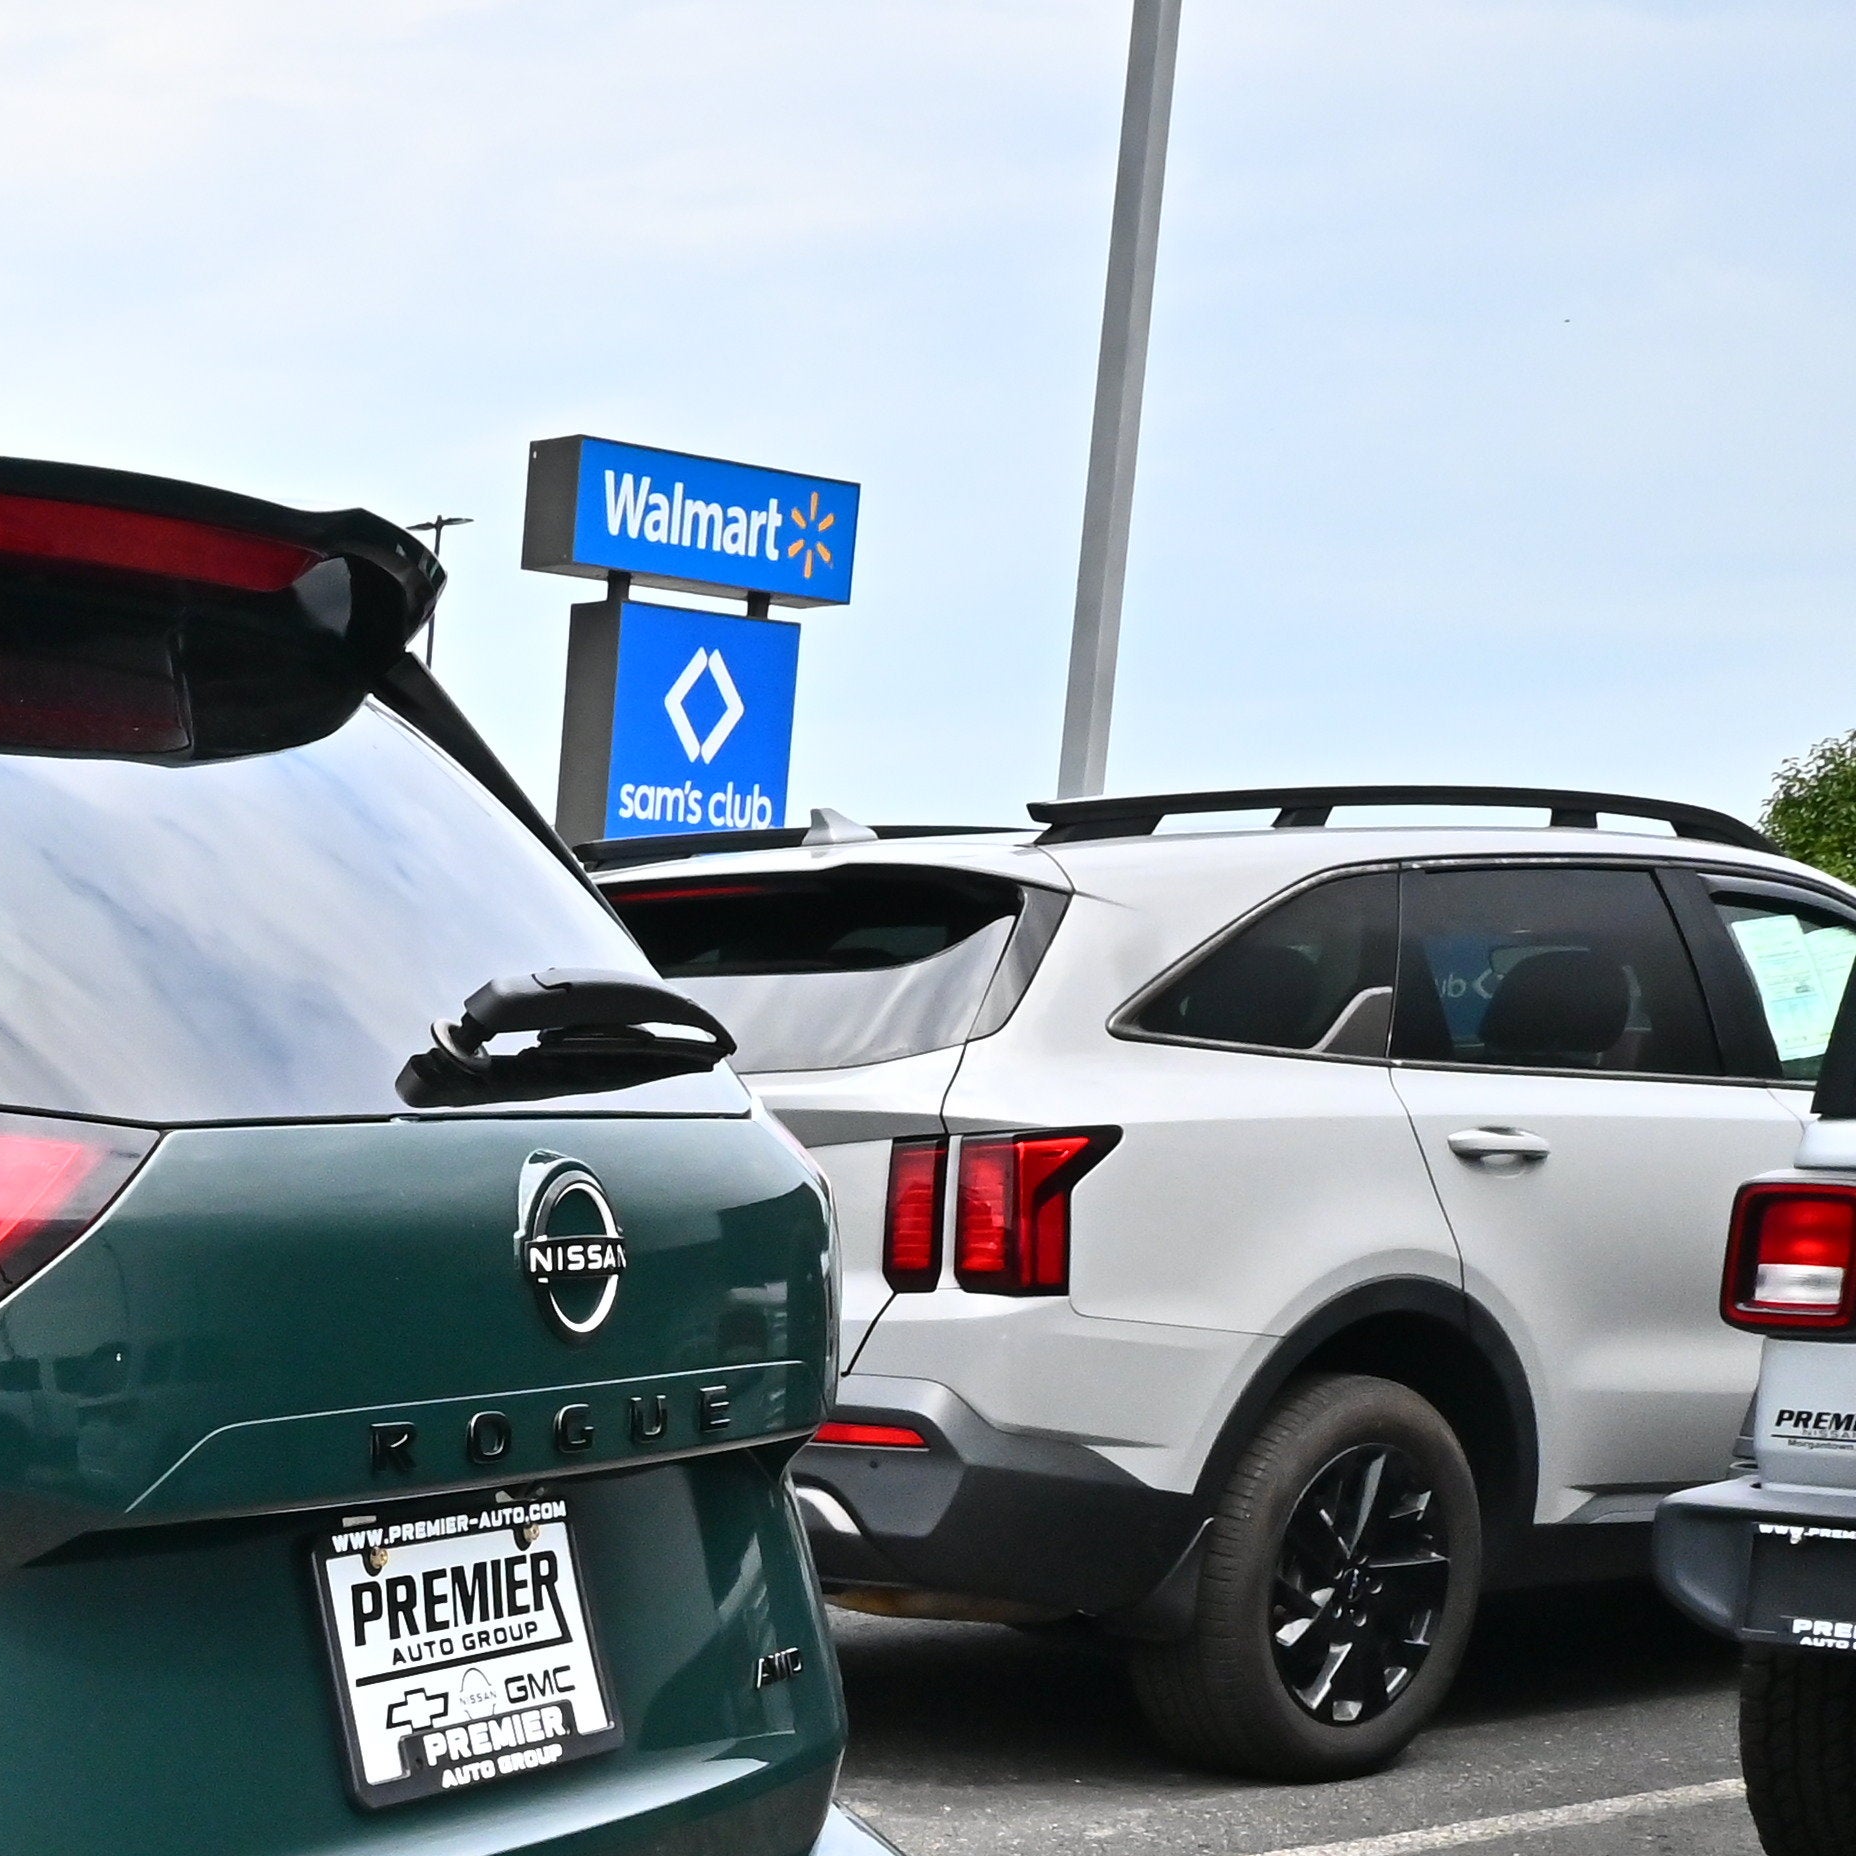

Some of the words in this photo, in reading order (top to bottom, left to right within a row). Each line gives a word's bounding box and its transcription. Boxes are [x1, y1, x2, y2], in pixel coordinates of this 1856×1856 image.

[603, 469, 783, 561] Walmart
[619, 781, 702, 824] sam's
[708, 781, 772, 829] club
[529, 1244, 627, 1273] NISSAN
[370, 1384, 732, 1474] ROGUE
[1774, 1409, 1856, 1432] PREM
[1802, 1429, 1856, 1440] NISSA
[331, 1500, 567, 1554] WWW.PREMIER-AUTO.COM
[350, 1550, 562, 1647] PREMIER
[392, 1637, 455, 1666] AUTO
[462, 1621, 538, 1651] GROUP
[1792, 1619, 1856, 1640] PRE
[1799, 1636, 1850, 1650] AUTO
[459, 1690, 497, 1705] NISSAN
[504, 1665, 576, 1704] GMC
[422, 1705, 568, 1768] PREMIER
[441, 1758, 497, 1789] AUTO
[497, 1744, 563, 1776] GROUP
